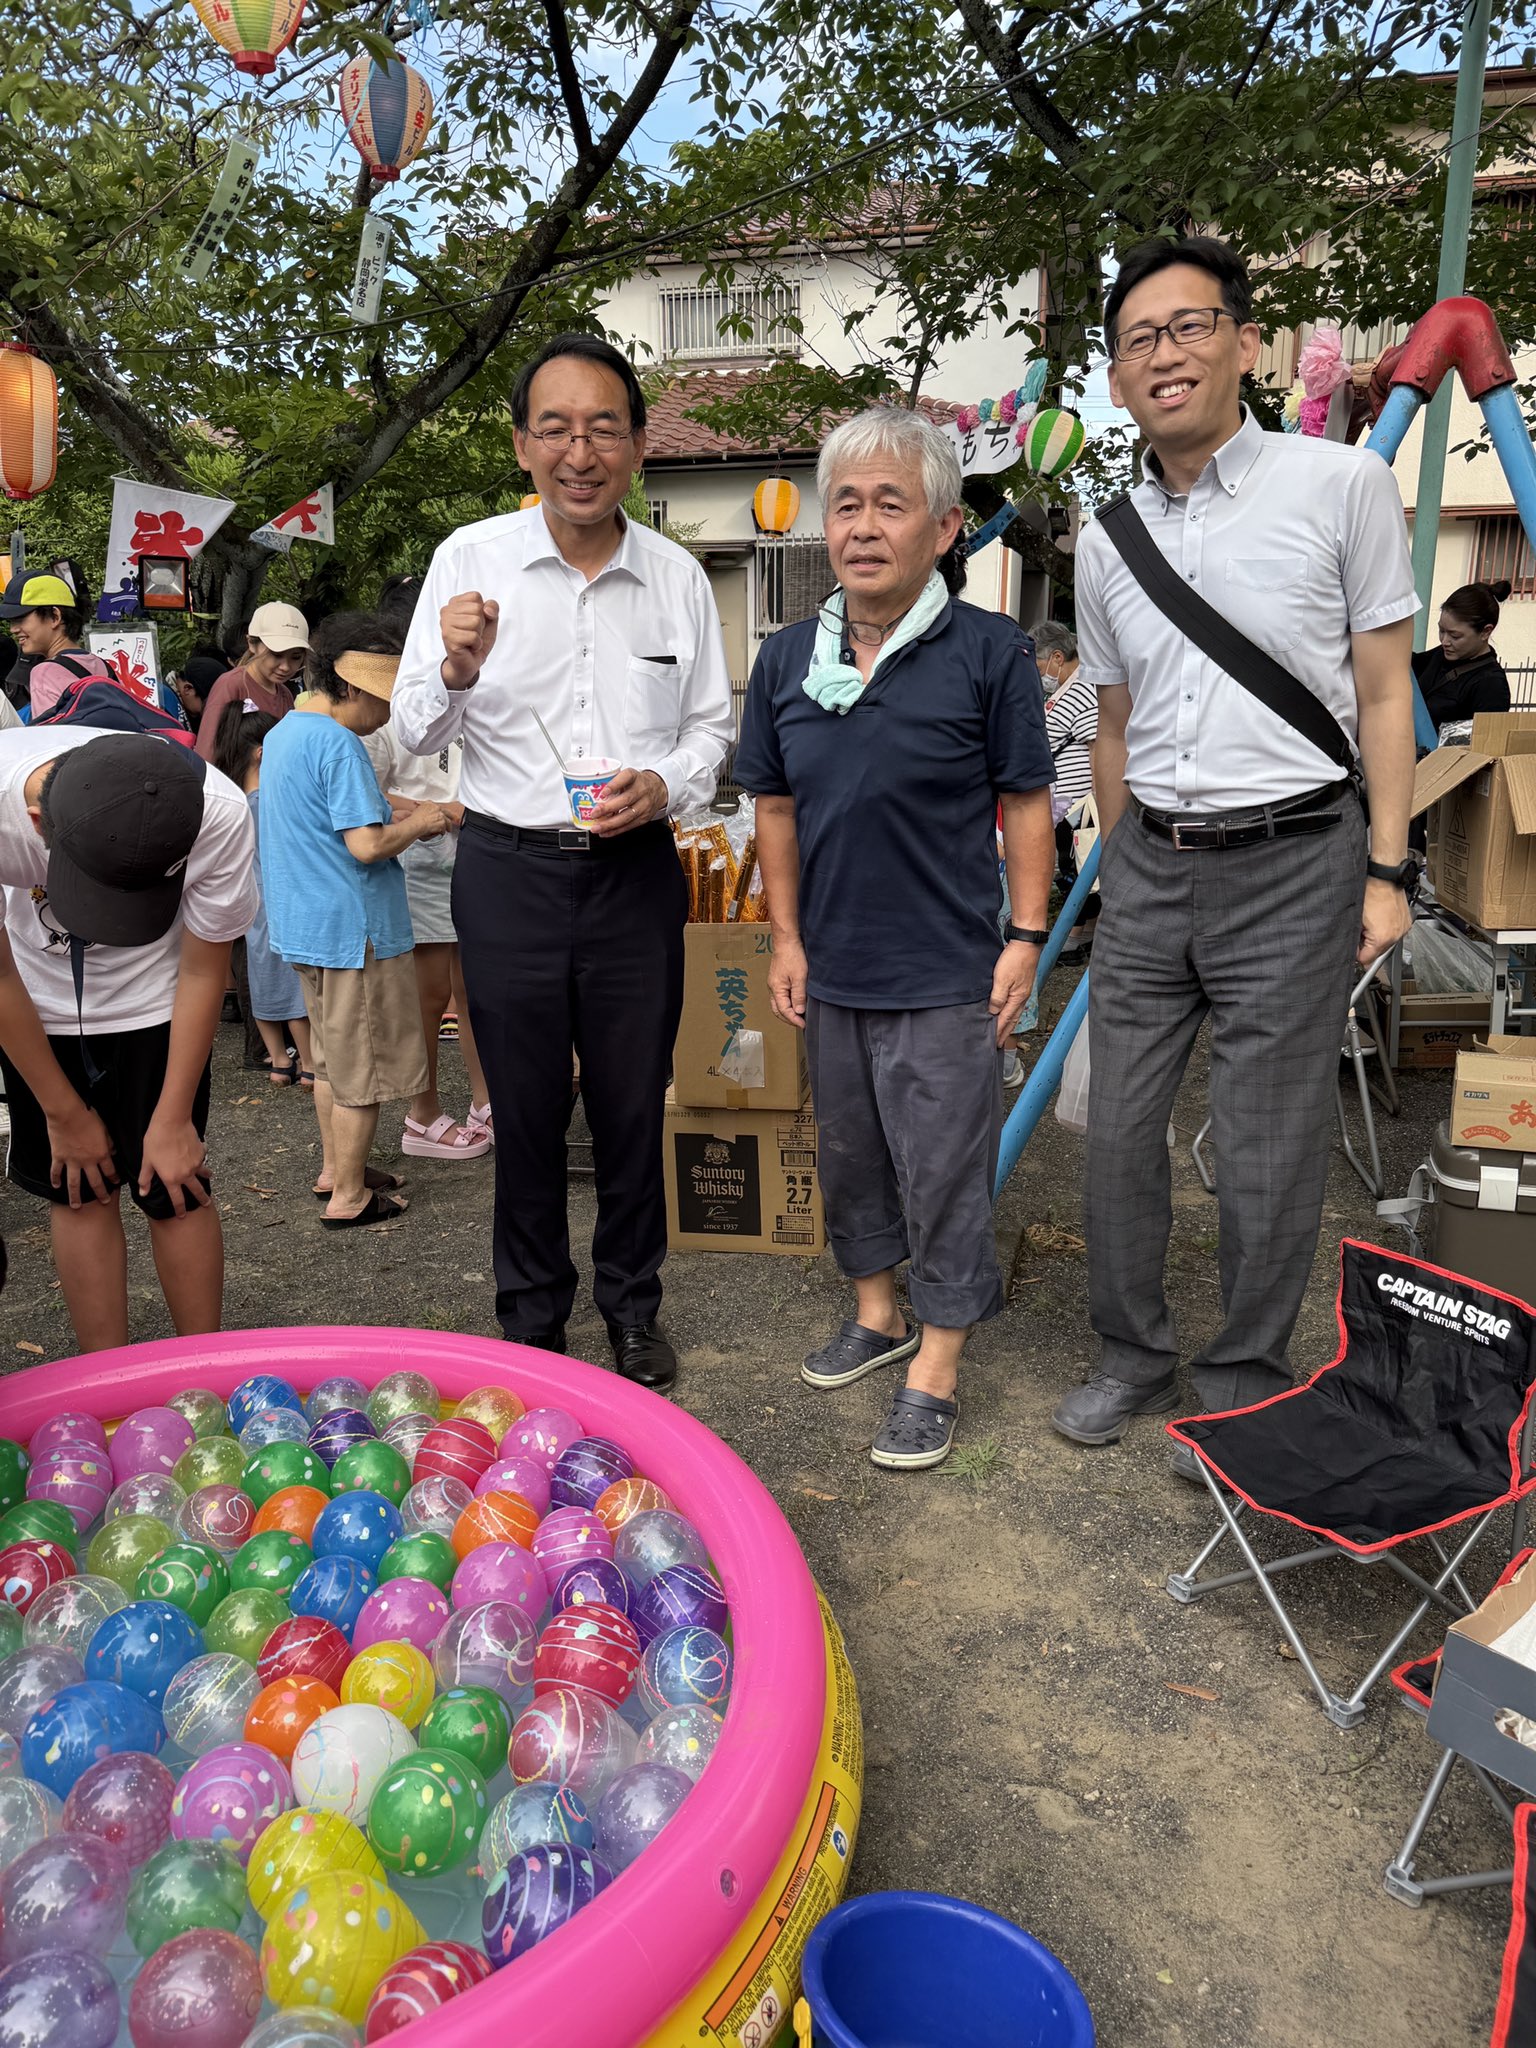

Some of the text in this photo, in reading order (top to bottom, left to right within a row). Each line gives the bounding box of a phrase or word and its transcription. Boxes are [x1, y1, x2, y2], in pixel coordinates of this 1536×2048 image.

[690, 1165, 746, 1183] Suntory
[693, 1181, 744, 1199] Whisky
[786, 1188, 813, 1205] 2.7
[786, 1205, 813, 1214] Liter
[703, 1222, 739, 1231] since 1937
[1377, 1273, 1512, 1340] CAPTAIN STAG
[1390, 1297, 1490, 1346] FREEDOM VENTURE SPIRITS
[831, 1716, 844, 1754] WARNING!
[818, 1798, 840, 1857] PREVENT DROWNING
[782, 1866, 807, 1909] WARNING
[717, 1957, 774, 2039] NO DIVING OR JUMPING
[730, 1974, 774, 2037] SHALLOW WATER
